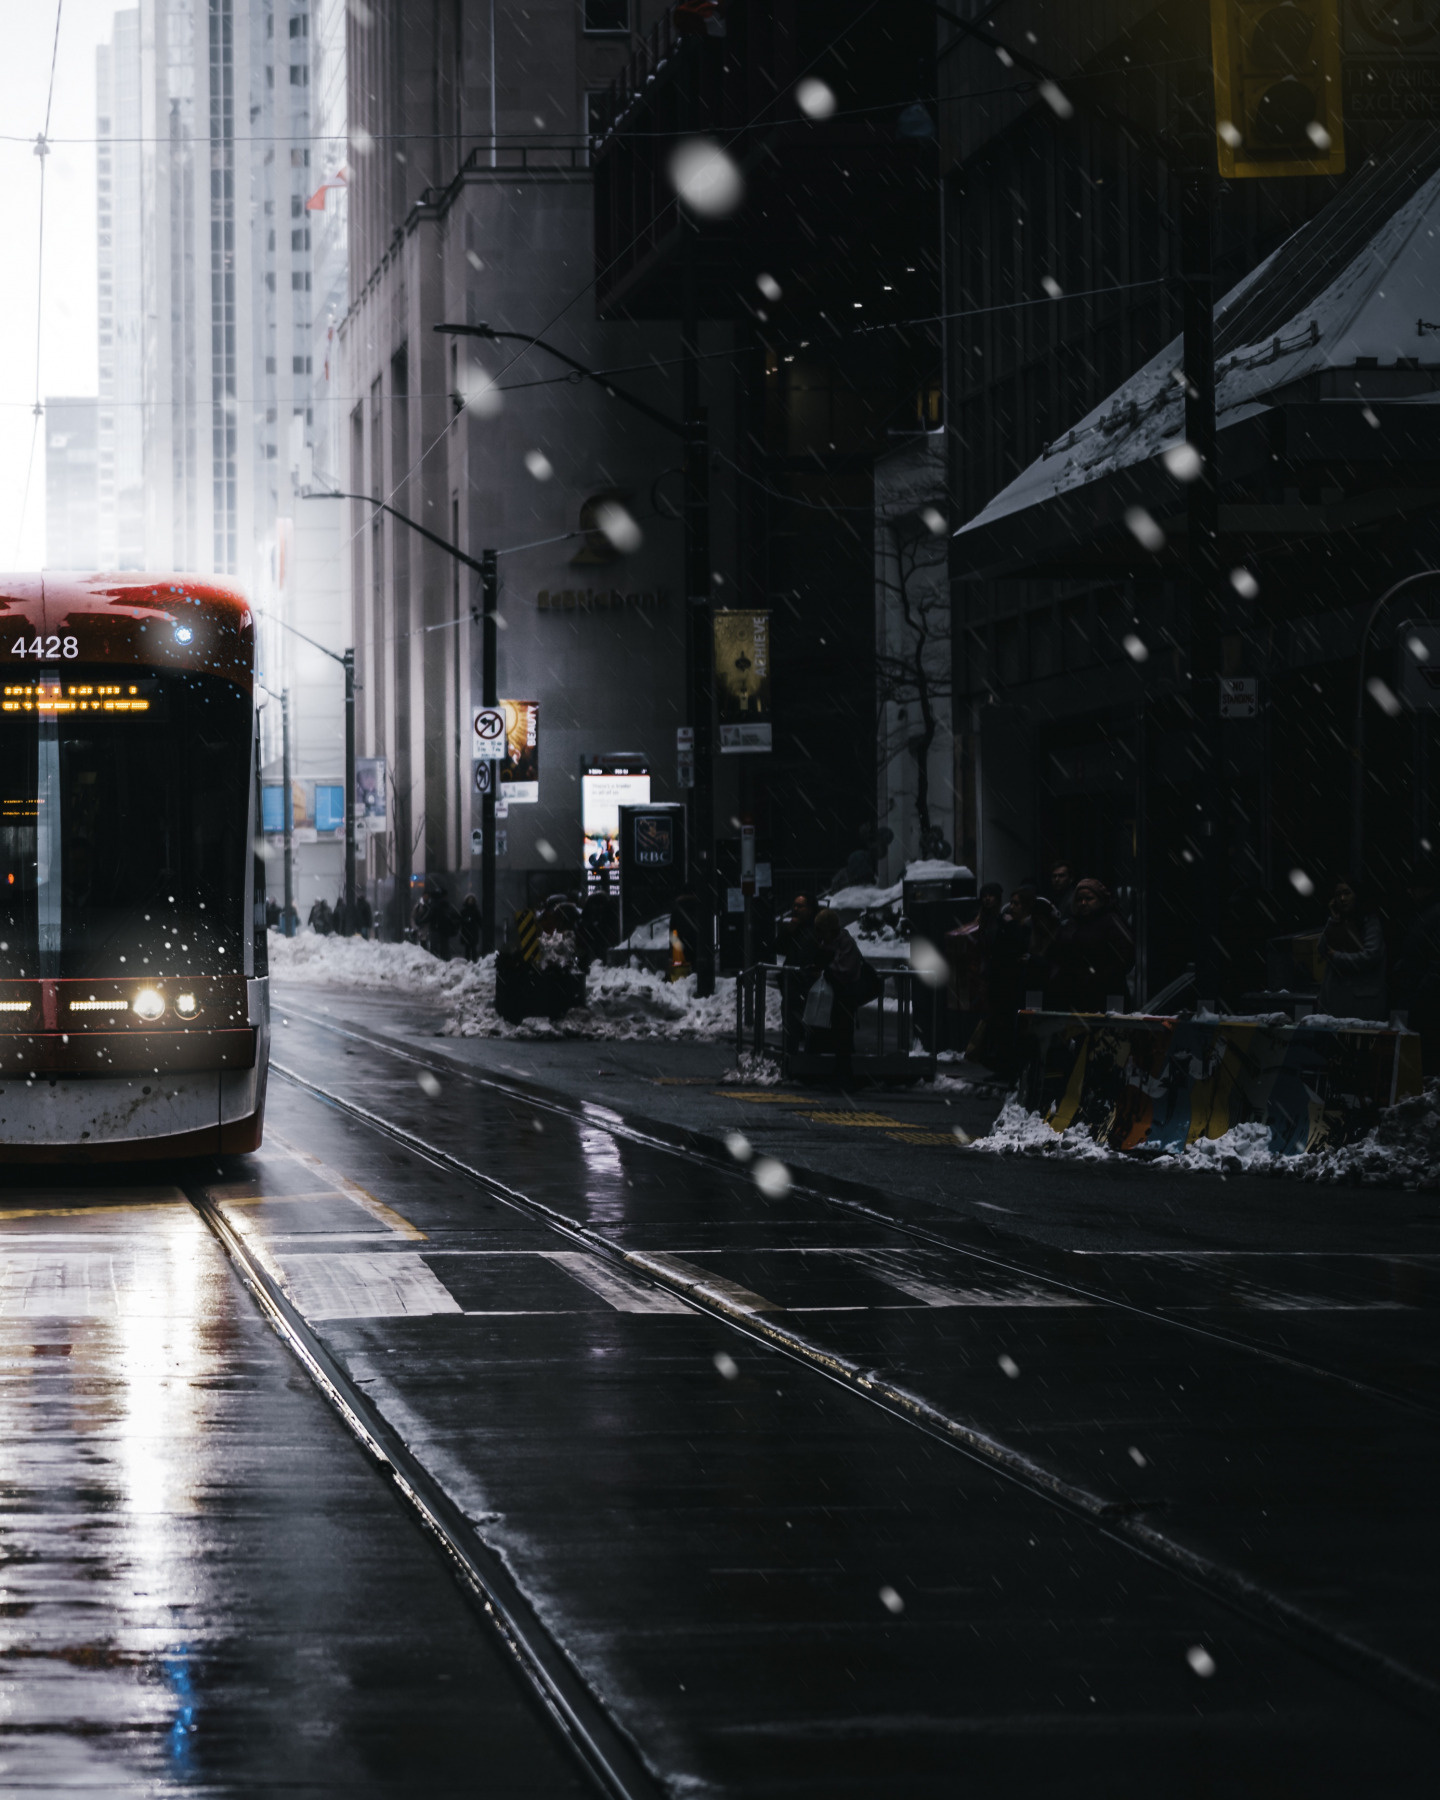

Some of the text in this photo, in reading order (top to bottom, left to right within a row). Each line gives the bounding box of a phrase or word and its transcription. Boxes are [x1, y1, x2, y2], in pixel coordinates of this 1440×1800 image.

[11, 636, 79, 658] 4428
[753, 616, 767, 677] ACHIEVE
[1232, 681, 1244, 691] NO
[1222, 693, 1254, 705] STANDING
[640, 851, 668, 862] RBC
